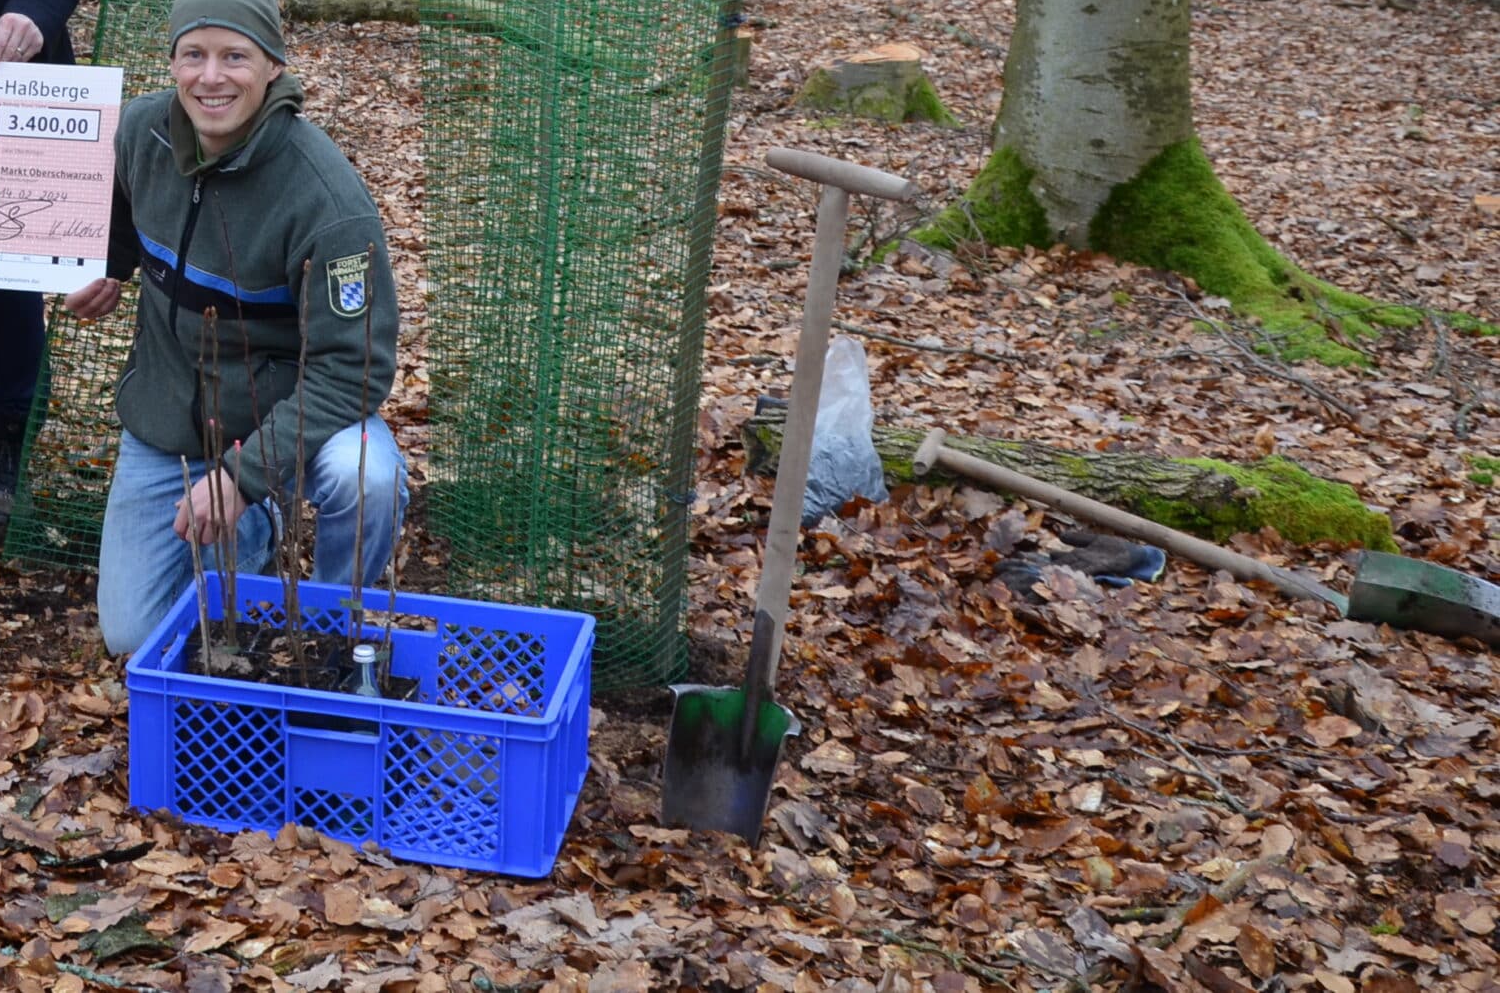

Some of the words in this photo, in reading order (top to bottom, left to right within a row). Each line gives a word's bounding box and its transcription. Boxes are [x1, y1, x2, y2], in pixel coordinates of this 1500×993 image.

[8, 114, 89, 136] 3.400,00
[1, 165, 28, 177] Markt
[29, 168, 103, 182] Oberschwarzach
[336, 257, 362, 269] FORST
